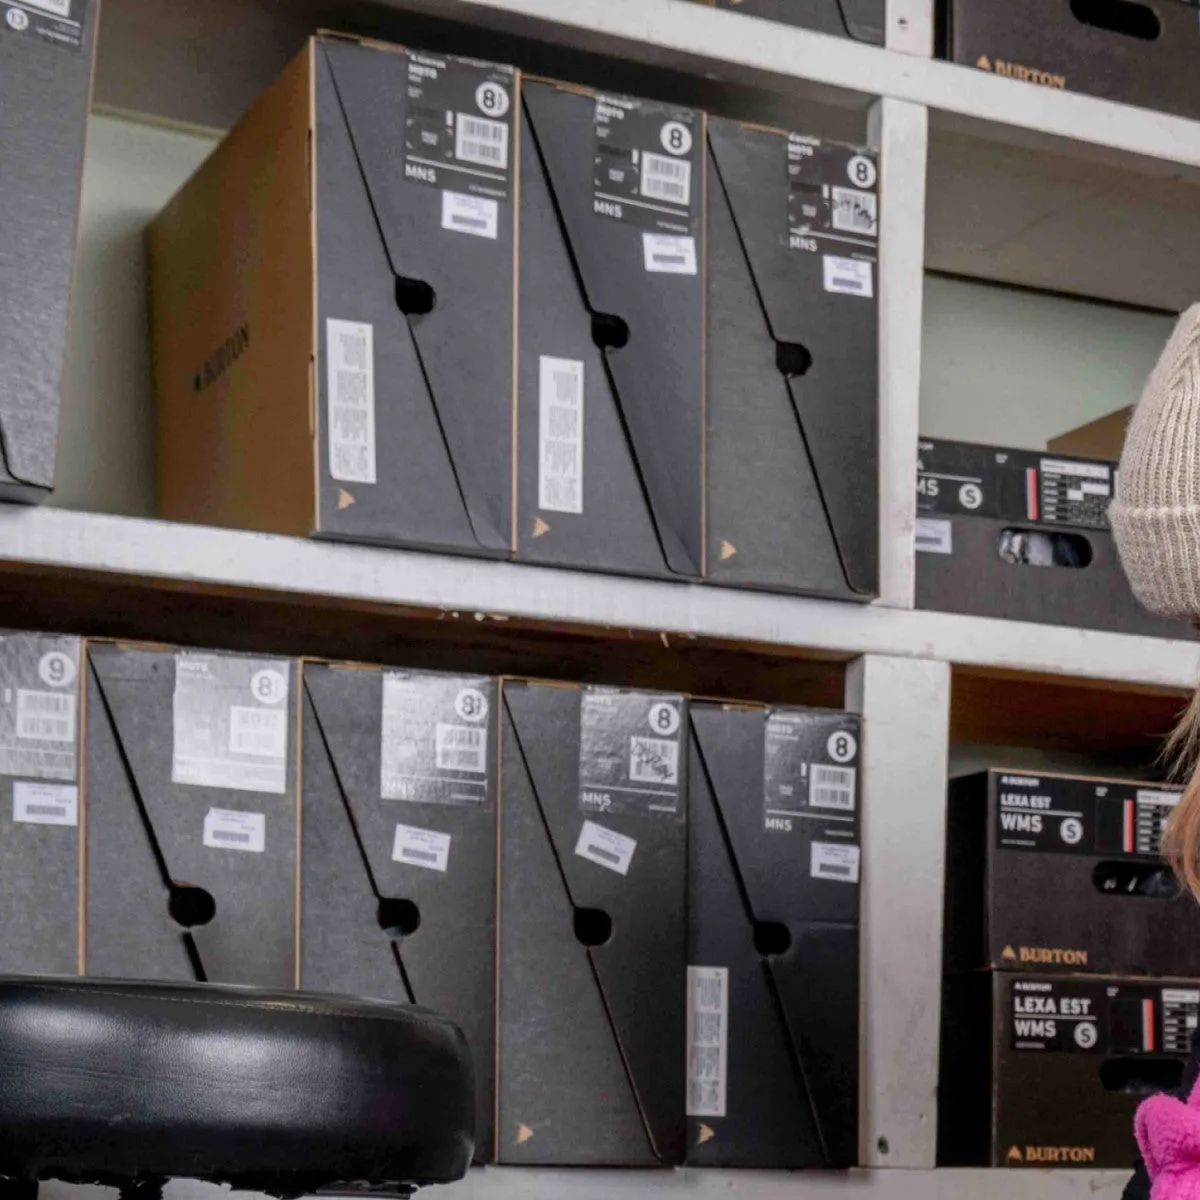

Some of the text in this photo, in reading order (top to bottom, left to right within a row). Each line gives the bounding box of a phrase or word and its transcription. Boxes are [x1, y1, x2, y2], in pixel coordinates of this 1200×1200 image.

[994, 59, 1066, 89] BURTON
[405, 164, 437, 183] MNS
[594, 200, 623, 218] MNS
[789, 236, 818, 252] MNS
[916, 478, 939, 496] MS
[582, 792, 612, 807] MNS
[1001, 793, 1052, 809] LEXA EST
[765, 817, 793, 832] MNS
[1001, 813, 1043, 832] WMS
[1019, 947, 1089, 965] BURTON
[1014, 996, 1091, 1015] LEXA EST
[1014, 1020, 1057, 1038] WMS
[1025, 1146, 1095, 1161] BURTON
